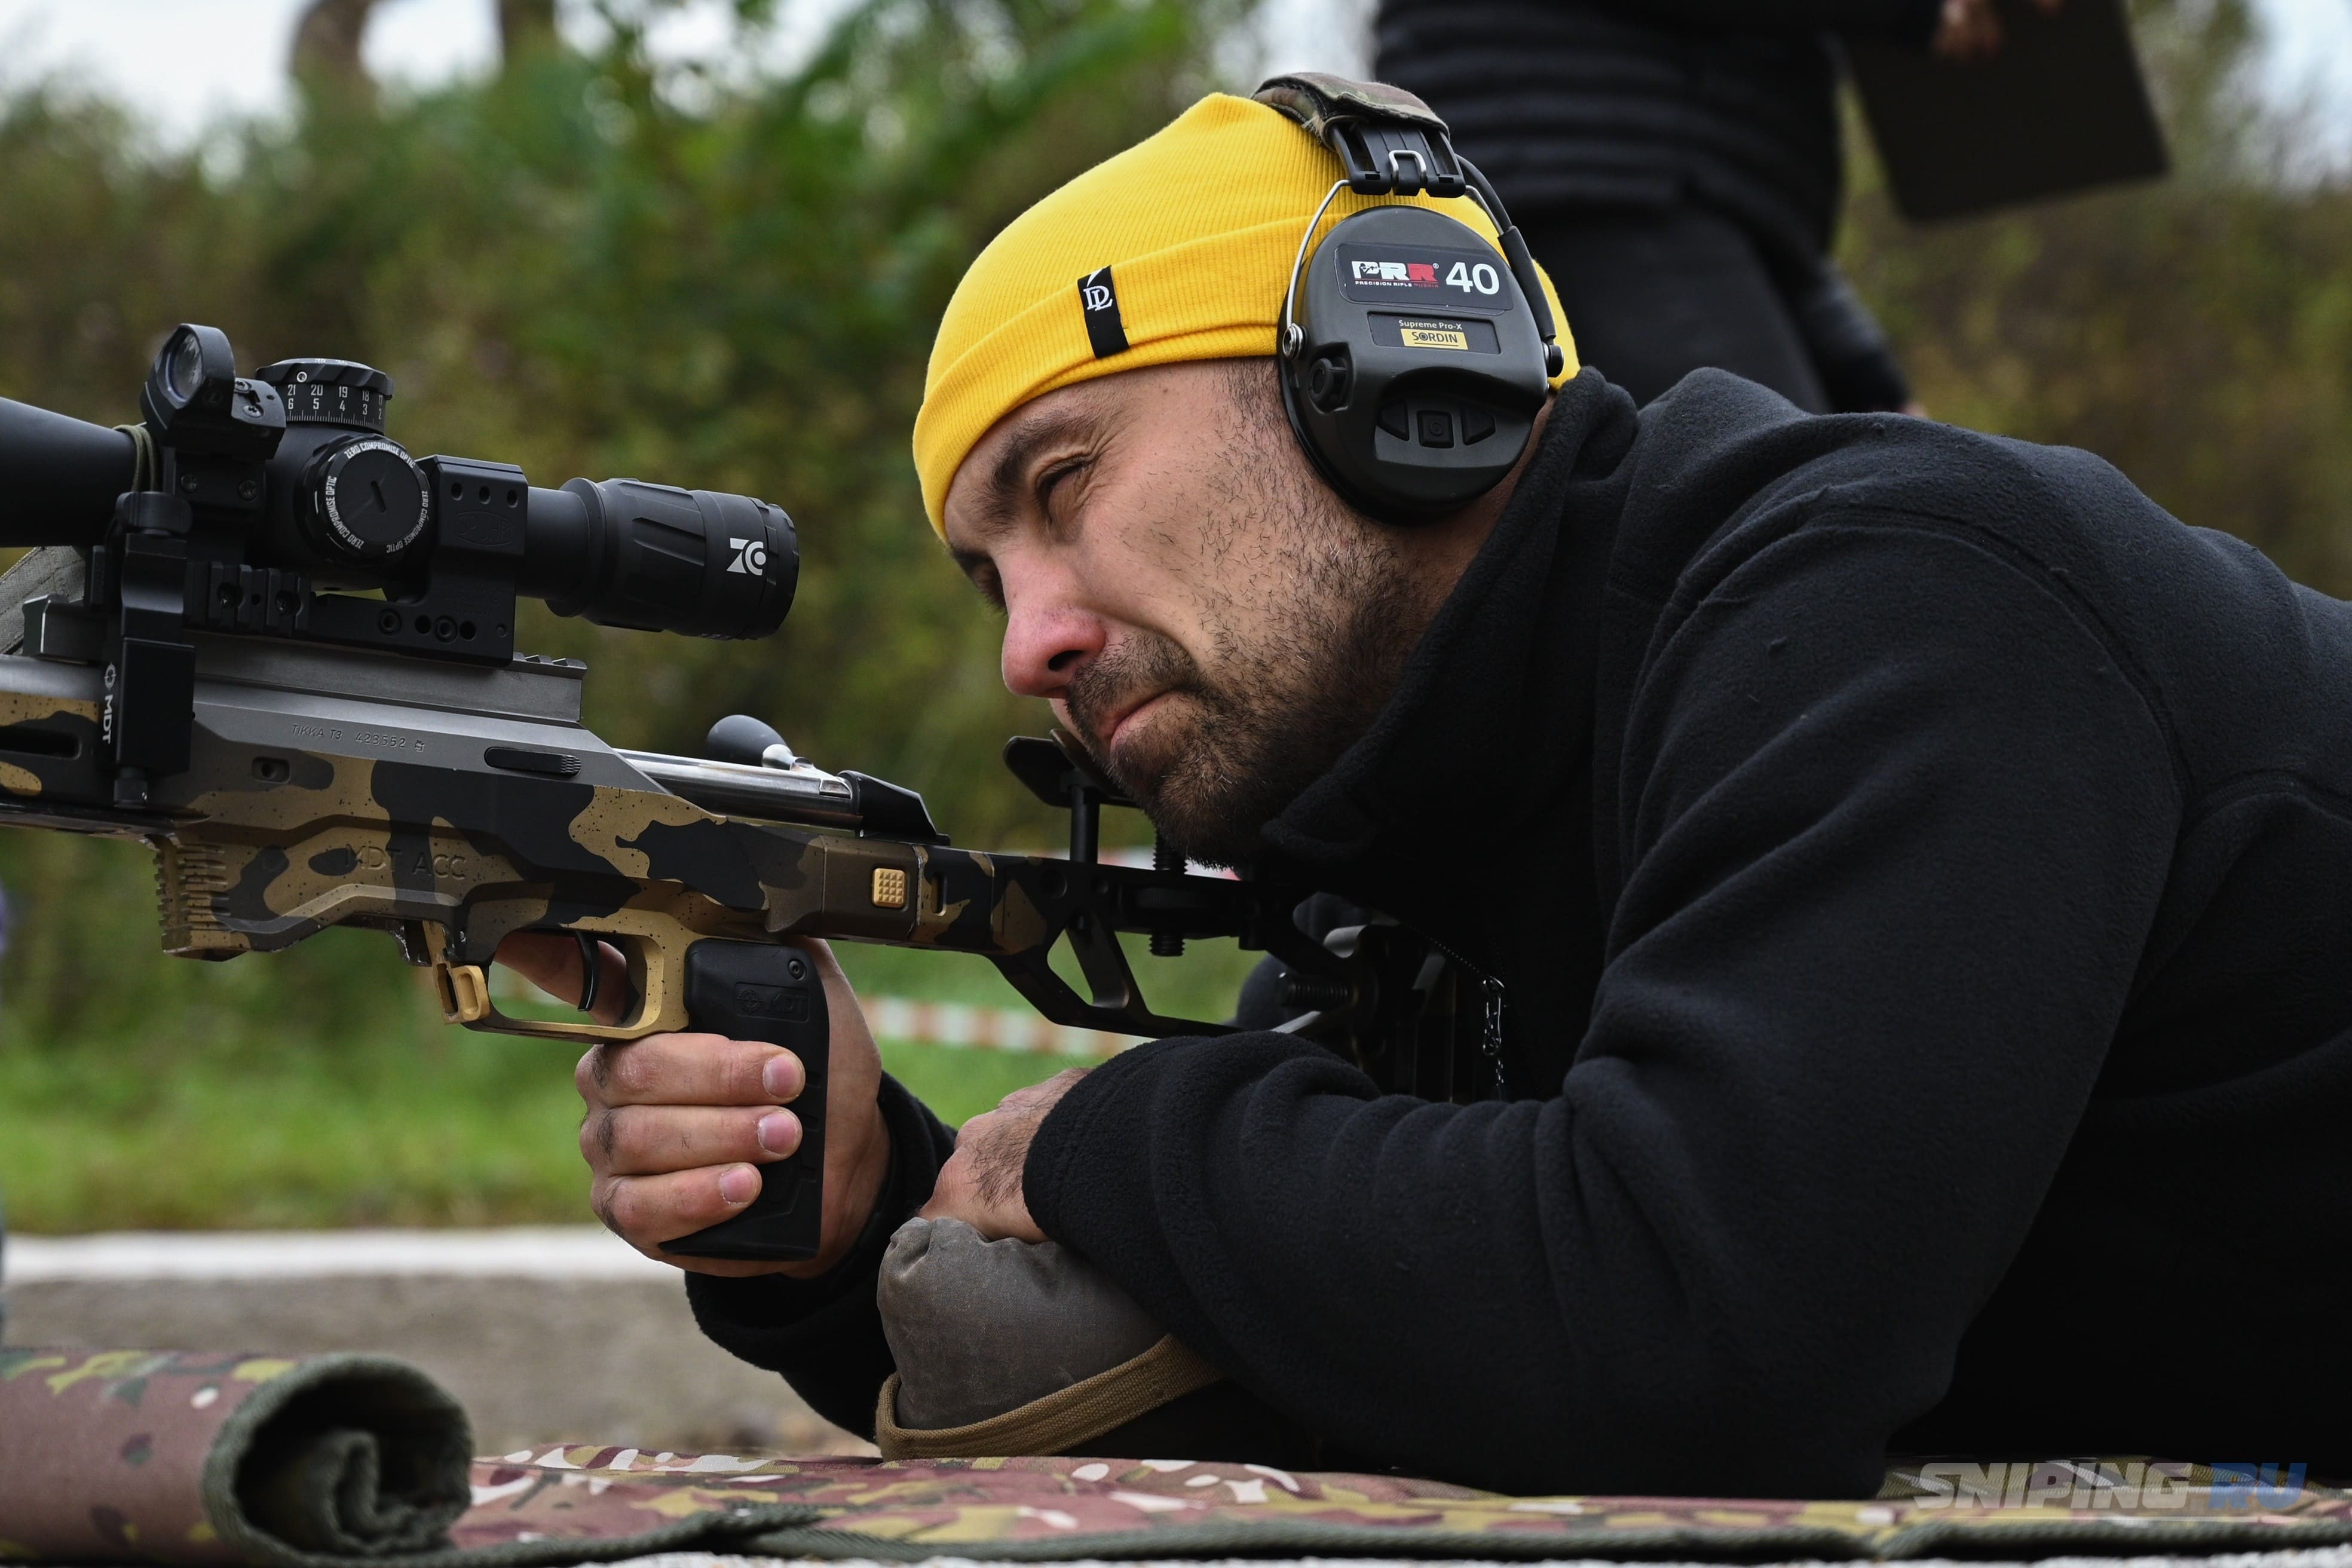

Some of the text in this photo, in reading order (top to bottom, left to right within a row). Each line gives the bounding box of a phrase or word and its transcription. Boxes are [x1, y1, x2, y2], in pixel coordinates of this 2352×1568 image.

[1399, 319, 1463, 330] Supreme Pro-X
[1413, 331, 1459, 344] SORDIN
[287, 384, 296, 396] 21
[311, 384, 323, 396] 20
[338, 386, 348, 398] 19
[362, 390, 370, 402] 18
[287, 398, 382, 419] 6 5 4 3 2
[344, 441, 416, 468] ZERO COMPROMISE OPTIC
[326, 475, 365, 549] ZERO COMPROMISE OPTIC
[404, 509, 428, 543] COMPROMISE
[386, 540, 404, 553] OPTIC
[103, 694, 114, 745] MDT
[291, 724, 325, 737] TIKKA
[330, 728, 343, 741] T3
[345, 843, 467, 880] MDT ACC
